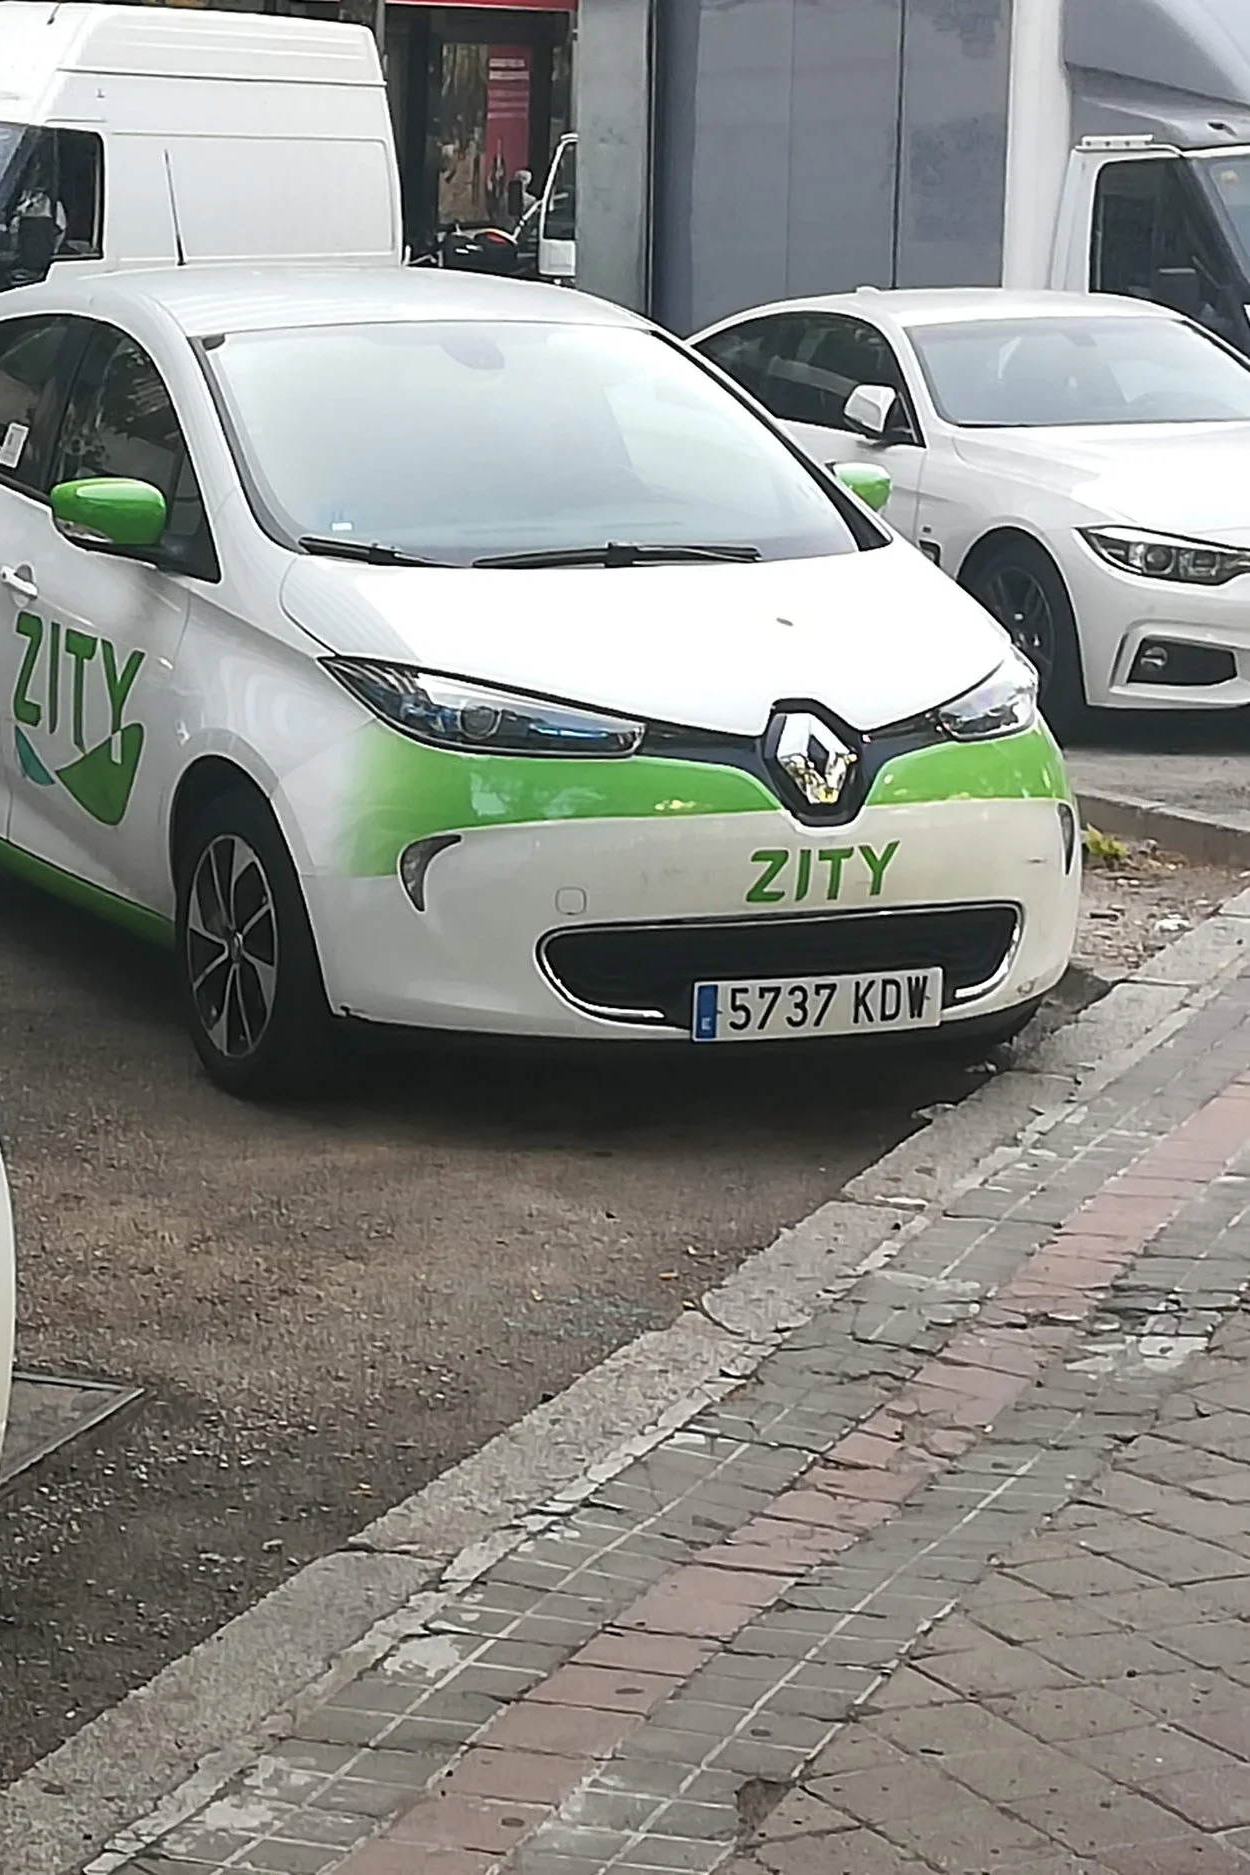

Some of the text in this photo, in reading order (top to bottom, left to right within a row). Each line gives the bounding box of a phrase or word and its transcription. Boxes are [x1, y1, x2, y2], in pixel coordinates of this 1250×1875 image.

[13, 610, 146, 765] ZITY
[746, 840, 901, 902] ZITY
[728, 982, 837, 1031] 5737
[853, 975, 928, 1024] KDW
